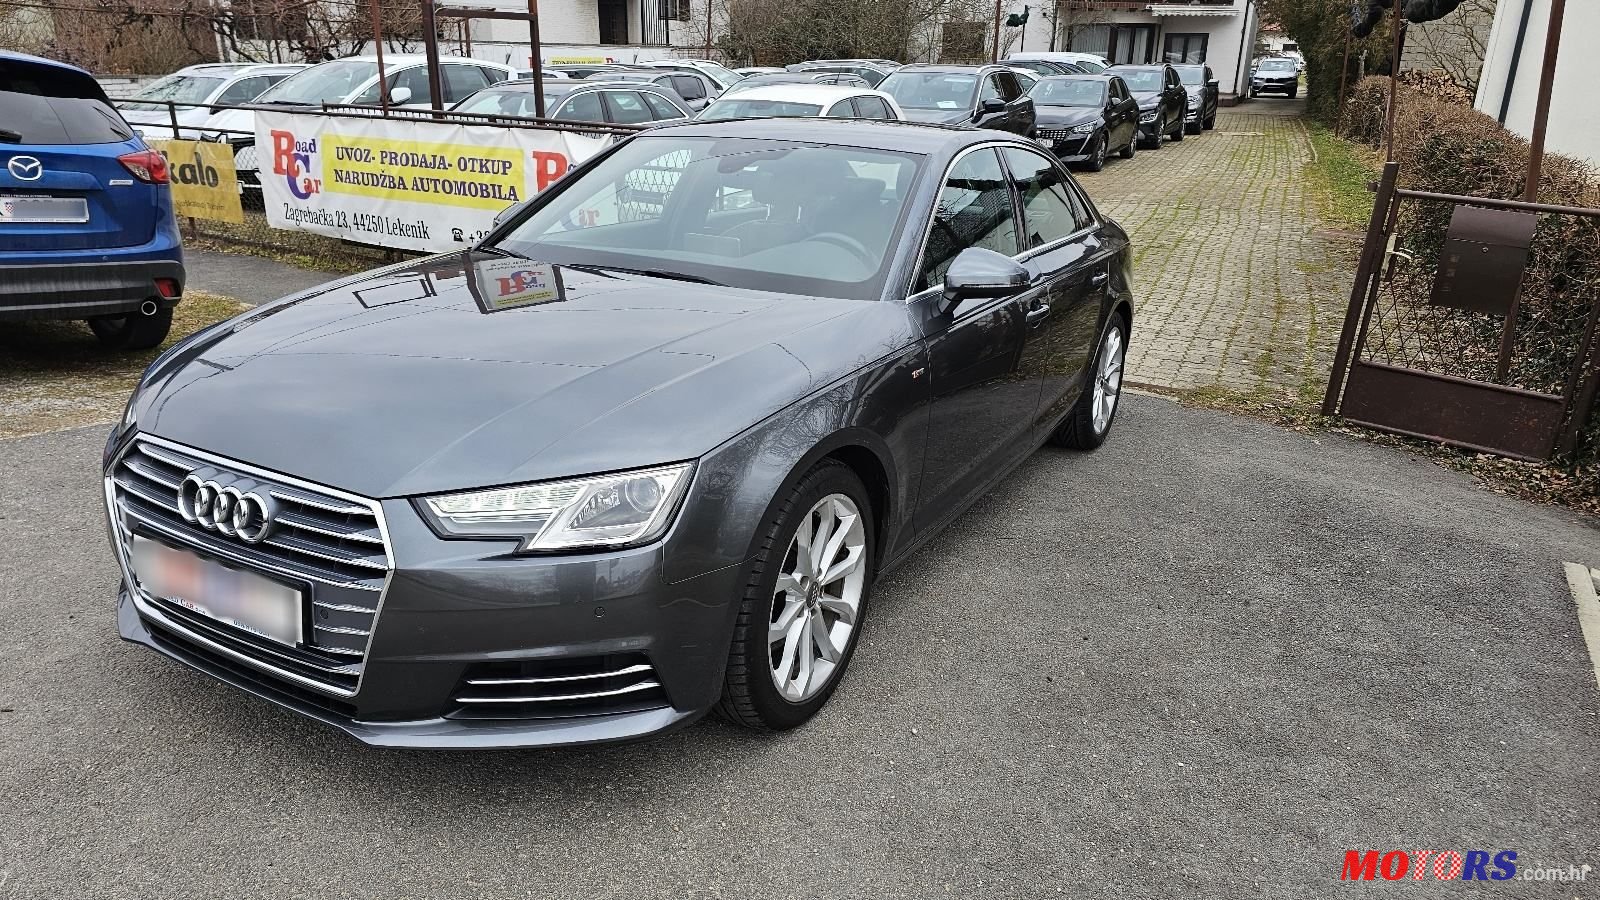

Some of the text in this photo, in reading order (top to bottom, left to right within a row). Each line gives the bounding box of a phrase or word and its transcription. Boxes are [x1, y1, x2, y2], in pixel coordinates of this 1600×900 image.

[271, 129, 317, 178] Road
[336, 146, 512, 176] UVOZ- PRODAJA- OTKUP
[287, 152, 322, 200] Car
[334, 169, 519, 201] NARUDŽBA AUTOMOBILA
[284, 203, 431, 240] Zagrebačka 23, 44250 Lekenik
